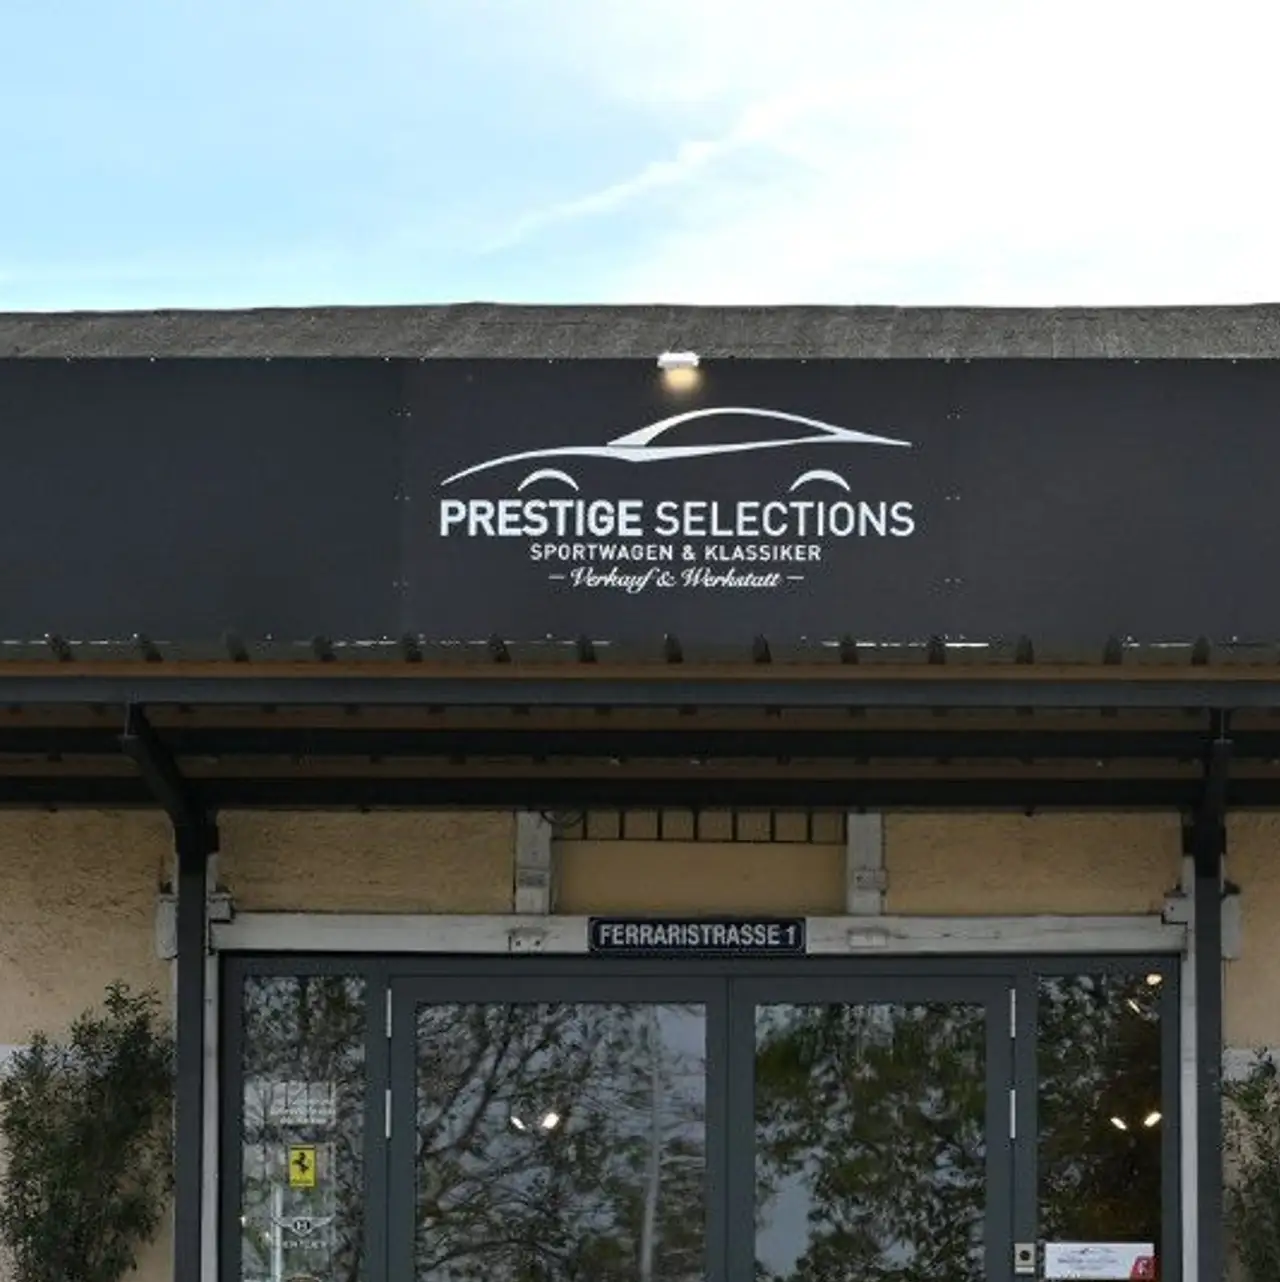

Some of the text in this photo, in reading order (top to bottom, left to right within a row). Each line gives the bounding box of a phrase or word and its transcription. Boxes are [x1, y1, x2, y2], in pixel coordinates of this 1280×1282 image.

[439, 499, 915, 537] PRESTIGE SELECTIONS
[530, 543, 822, 562] SPORTWAGEN & KLASSIKER
[570, 566, 781, 595] Verkauf & Werkstatt
[599, 923, 797, 946] FERRARISTRASSE 1
